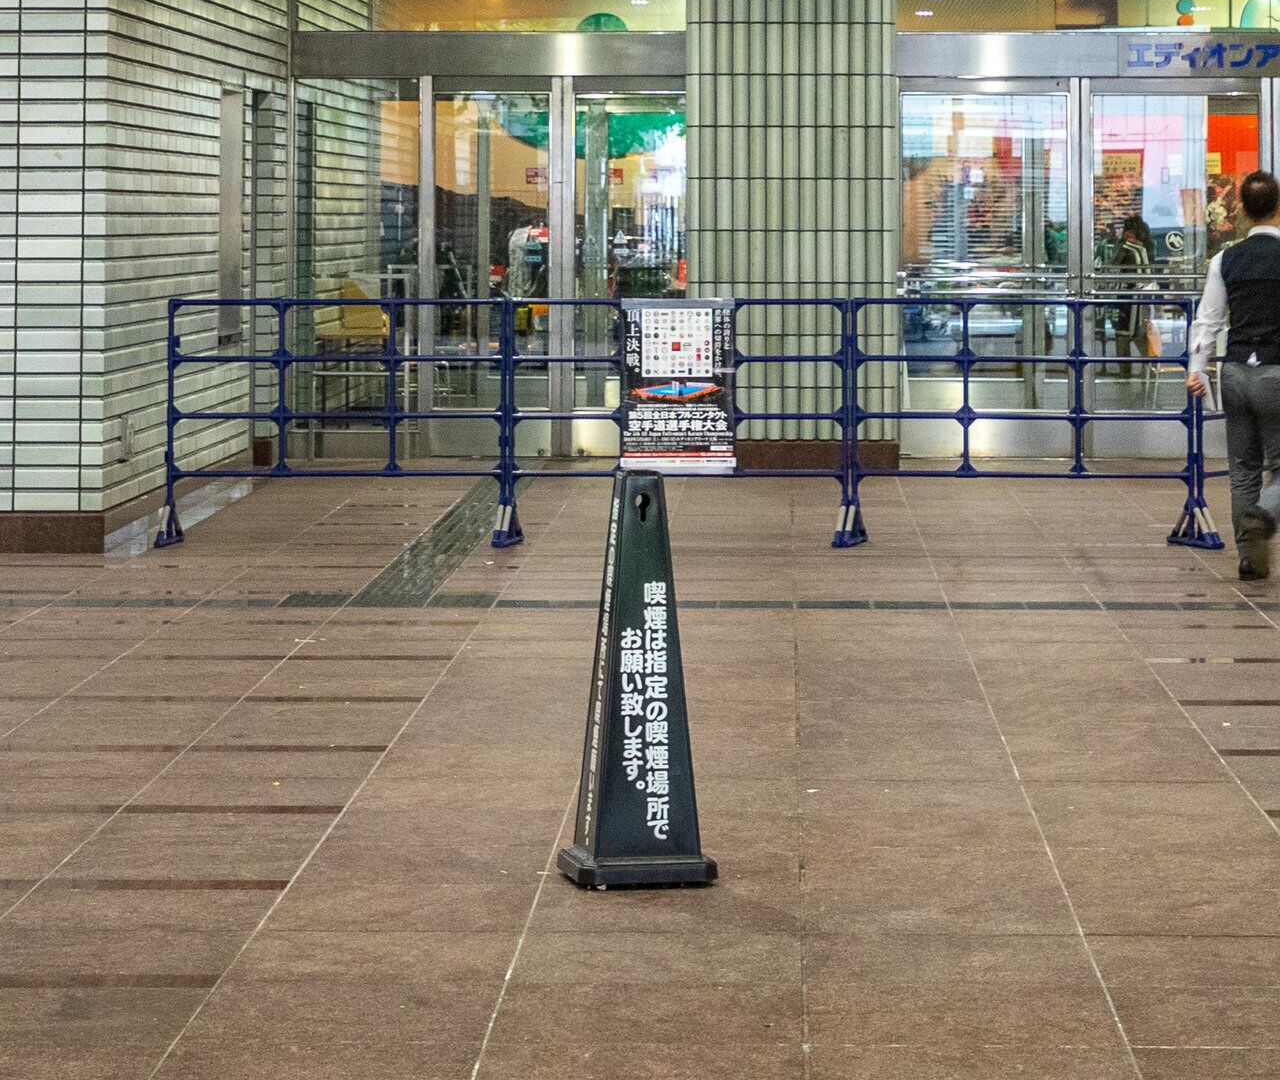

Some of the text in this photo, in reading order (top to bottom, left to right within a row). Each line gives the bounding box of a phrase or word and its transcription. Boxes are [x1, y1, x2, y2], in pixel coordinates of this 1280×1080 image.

[626, 308, 640, 373] 頂上決戦。
[628, 410, 728, 419] 第5回全日本フルコンタクト
[628, 420, 728, 431] 空手道選手権大会
[619, 627, 644, 789] お願い致します。
[643, 580, 670, 839] 喫煙は指定の喫煙場所で
